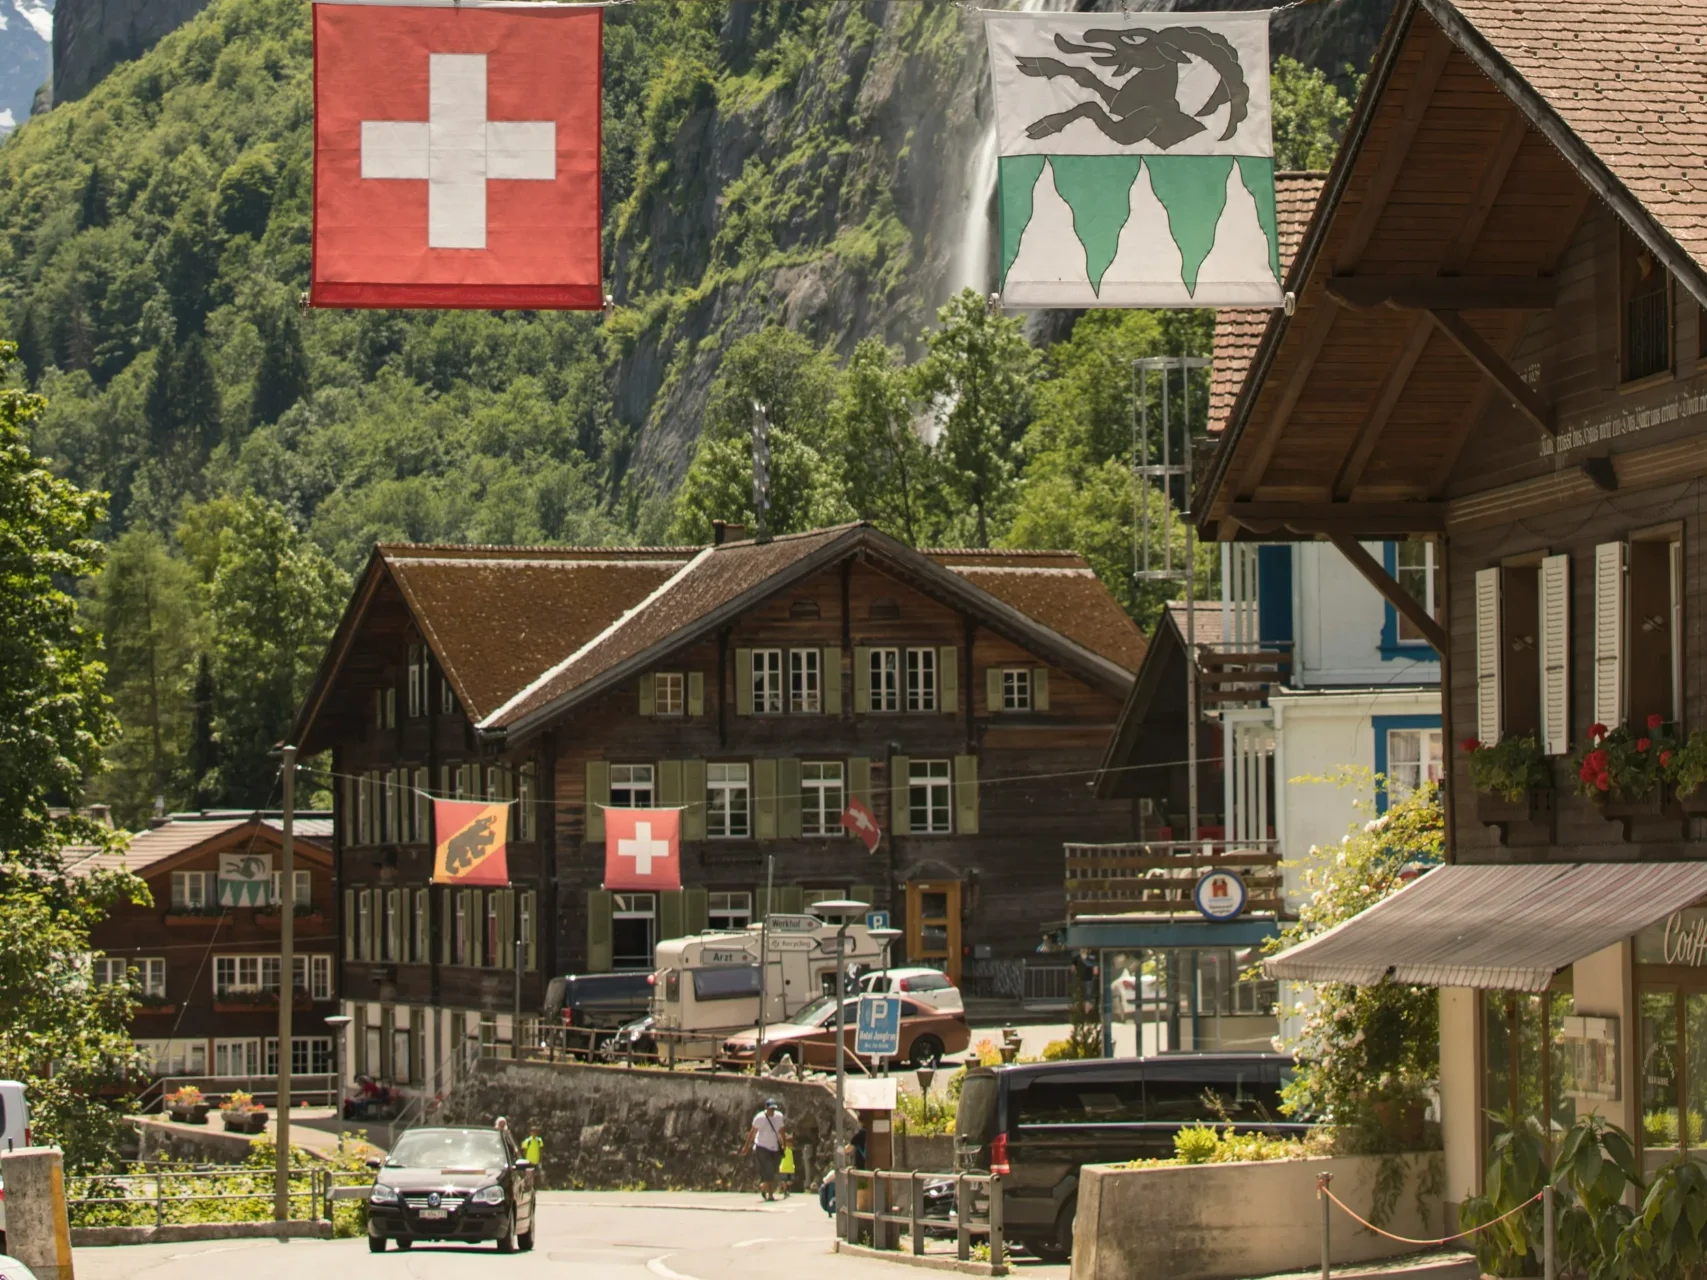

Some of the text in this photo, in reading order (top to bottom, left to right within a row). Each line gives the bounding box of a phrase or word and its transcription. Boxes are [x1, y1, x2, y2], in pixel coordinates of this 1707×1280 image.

[772, 917, 801, 929] Werkhof
[781, 940, 812, 950] Recycling
[713, 952, 733, 962] Arzt
[871, 999, 888, 1028] P
[859, 1031, 873, 1041] Hotel
